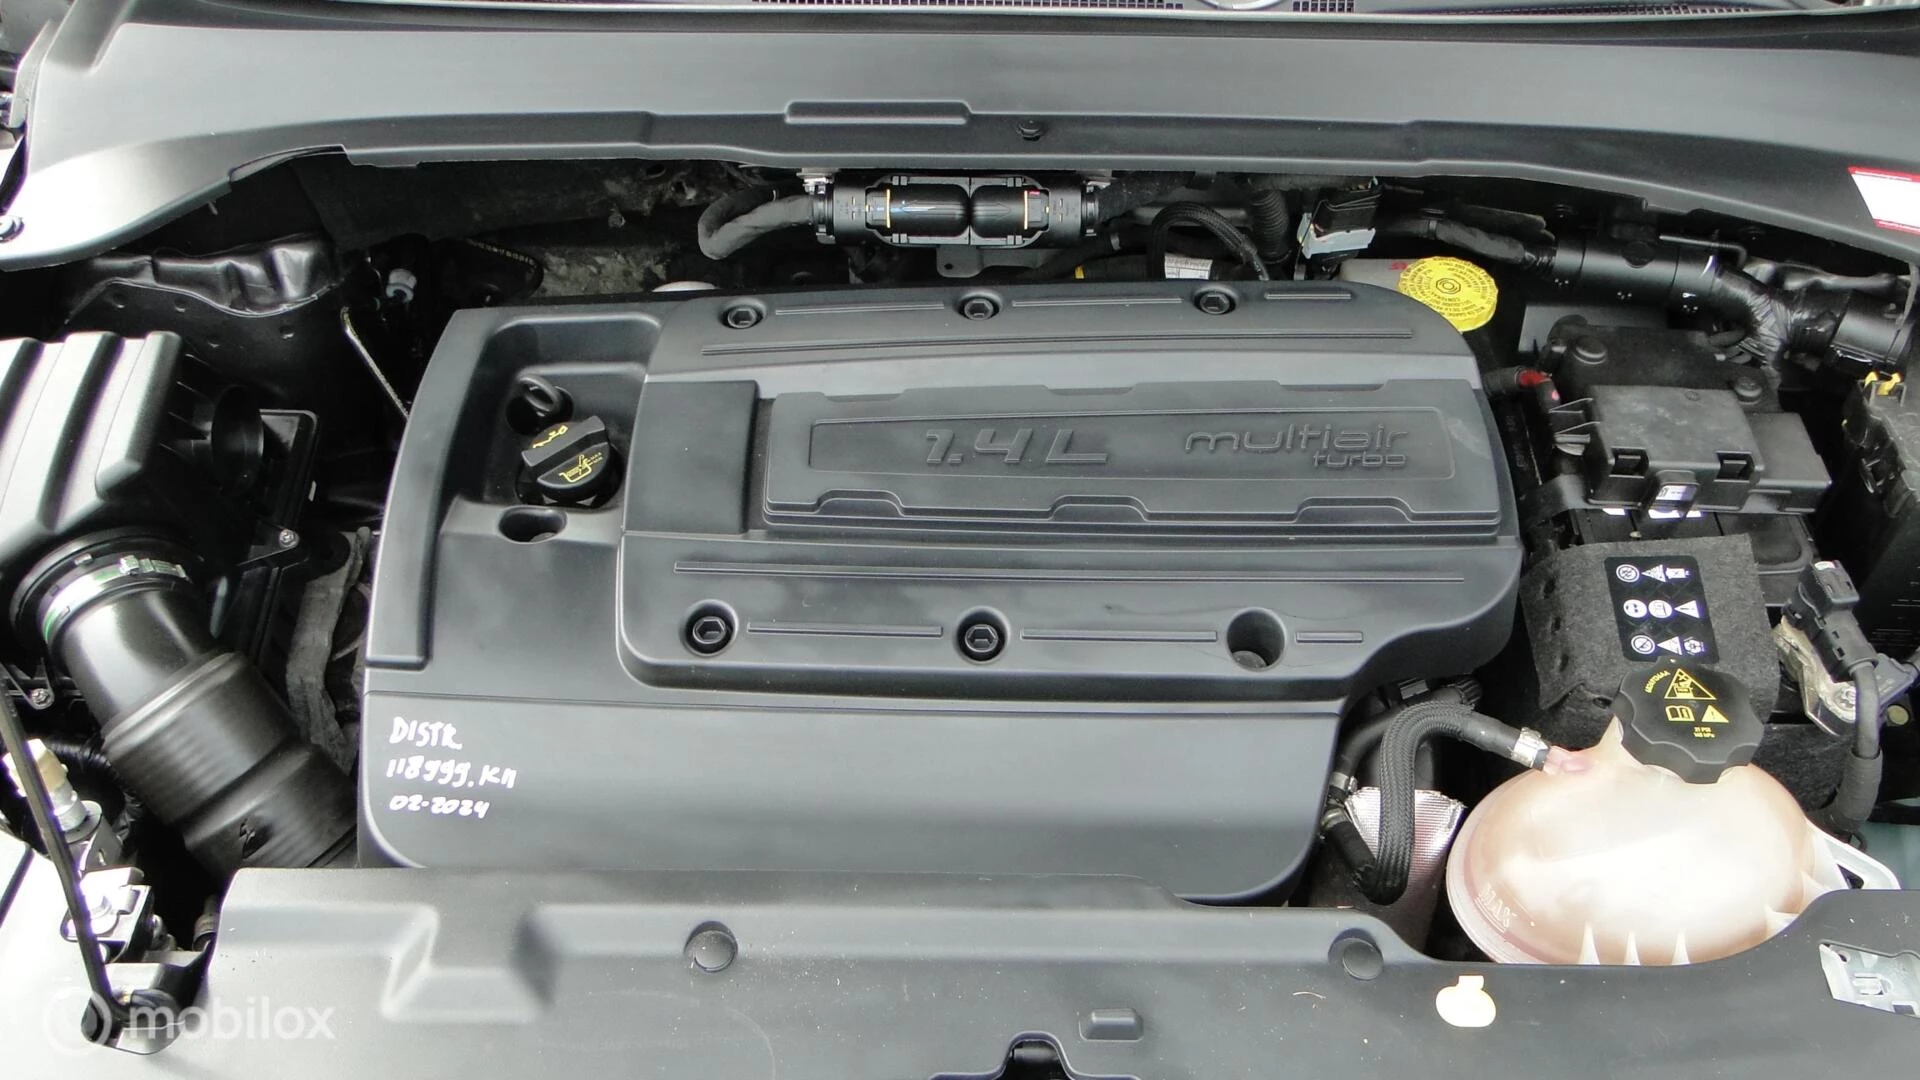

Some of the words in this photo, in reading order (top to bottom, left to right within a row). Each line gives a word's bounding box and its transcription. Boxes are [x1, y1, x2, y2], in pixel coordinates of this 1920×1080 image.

[1184, 423, 1409, 451] multiair
[1313, 451, 1407, 468] turbo
[389, 794, 490, 819] 02-2024
